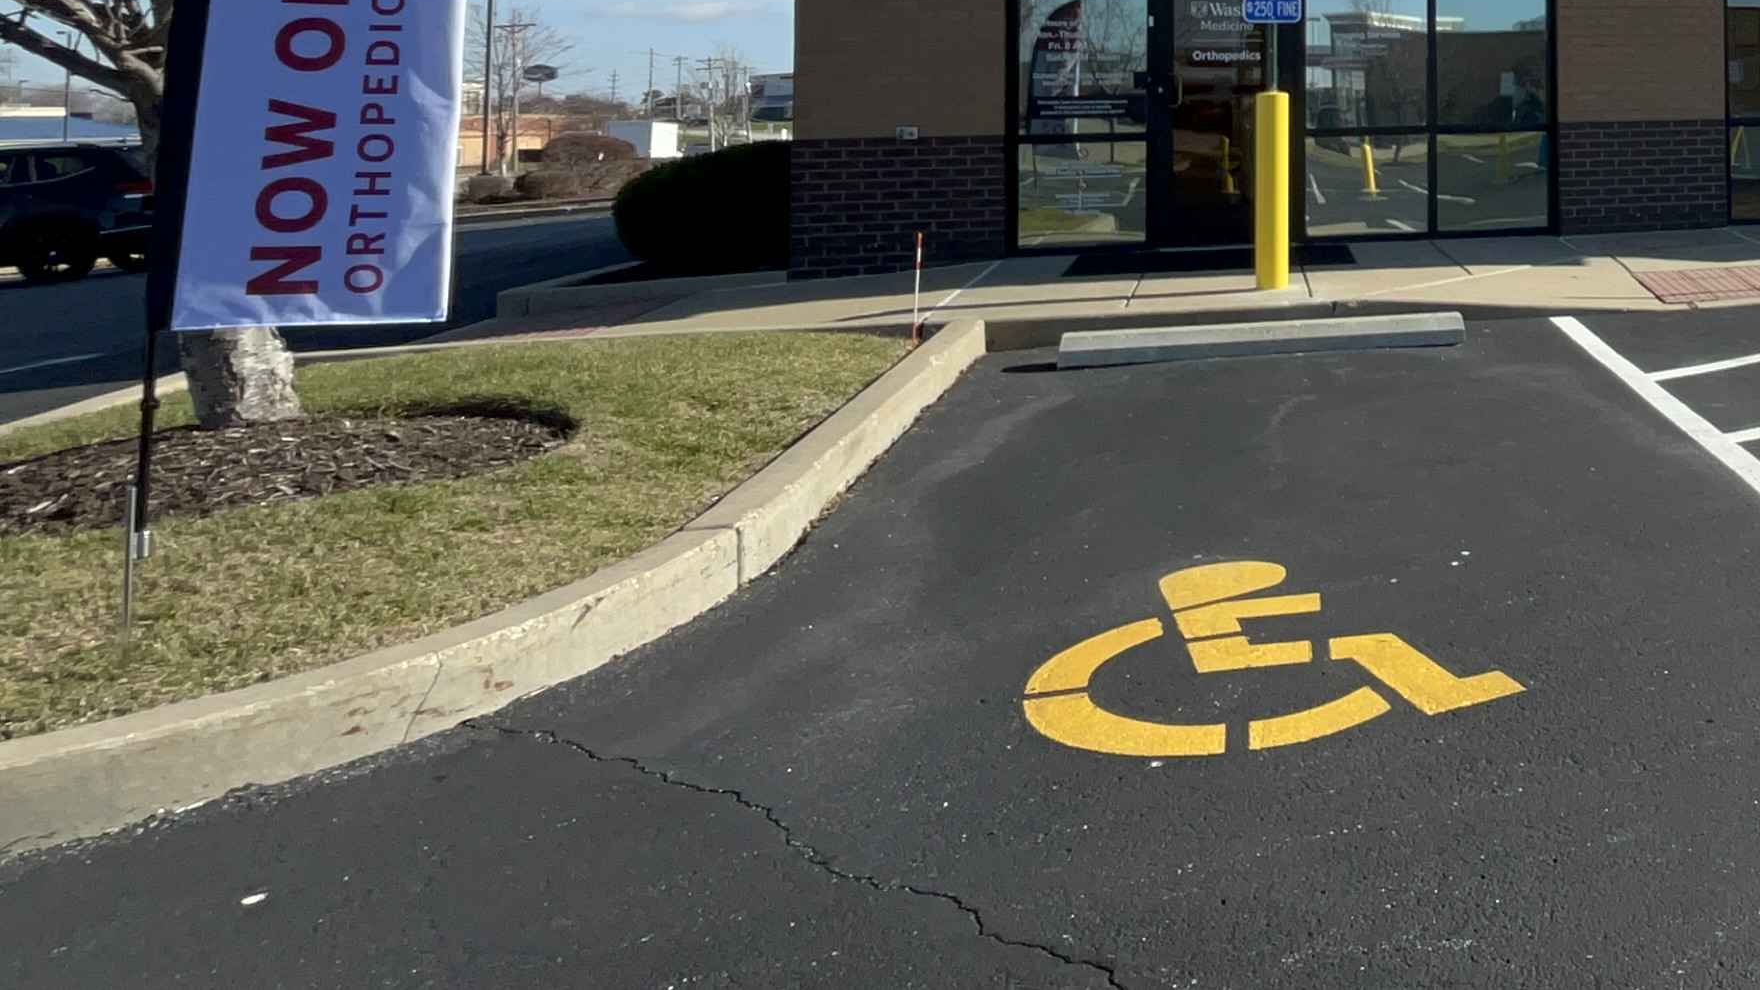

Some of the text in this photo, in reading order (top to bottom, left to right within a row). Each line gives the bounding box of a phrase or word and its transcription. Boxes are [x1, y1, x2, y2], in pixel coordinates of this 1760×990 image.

[1246, 1, 1299, 17] $250 FINE
[1200, 20, 1254, 32] Medicine
[1192, 49, 1262, 63] Orthopedics
[245, 97, 338, 297] NOW
